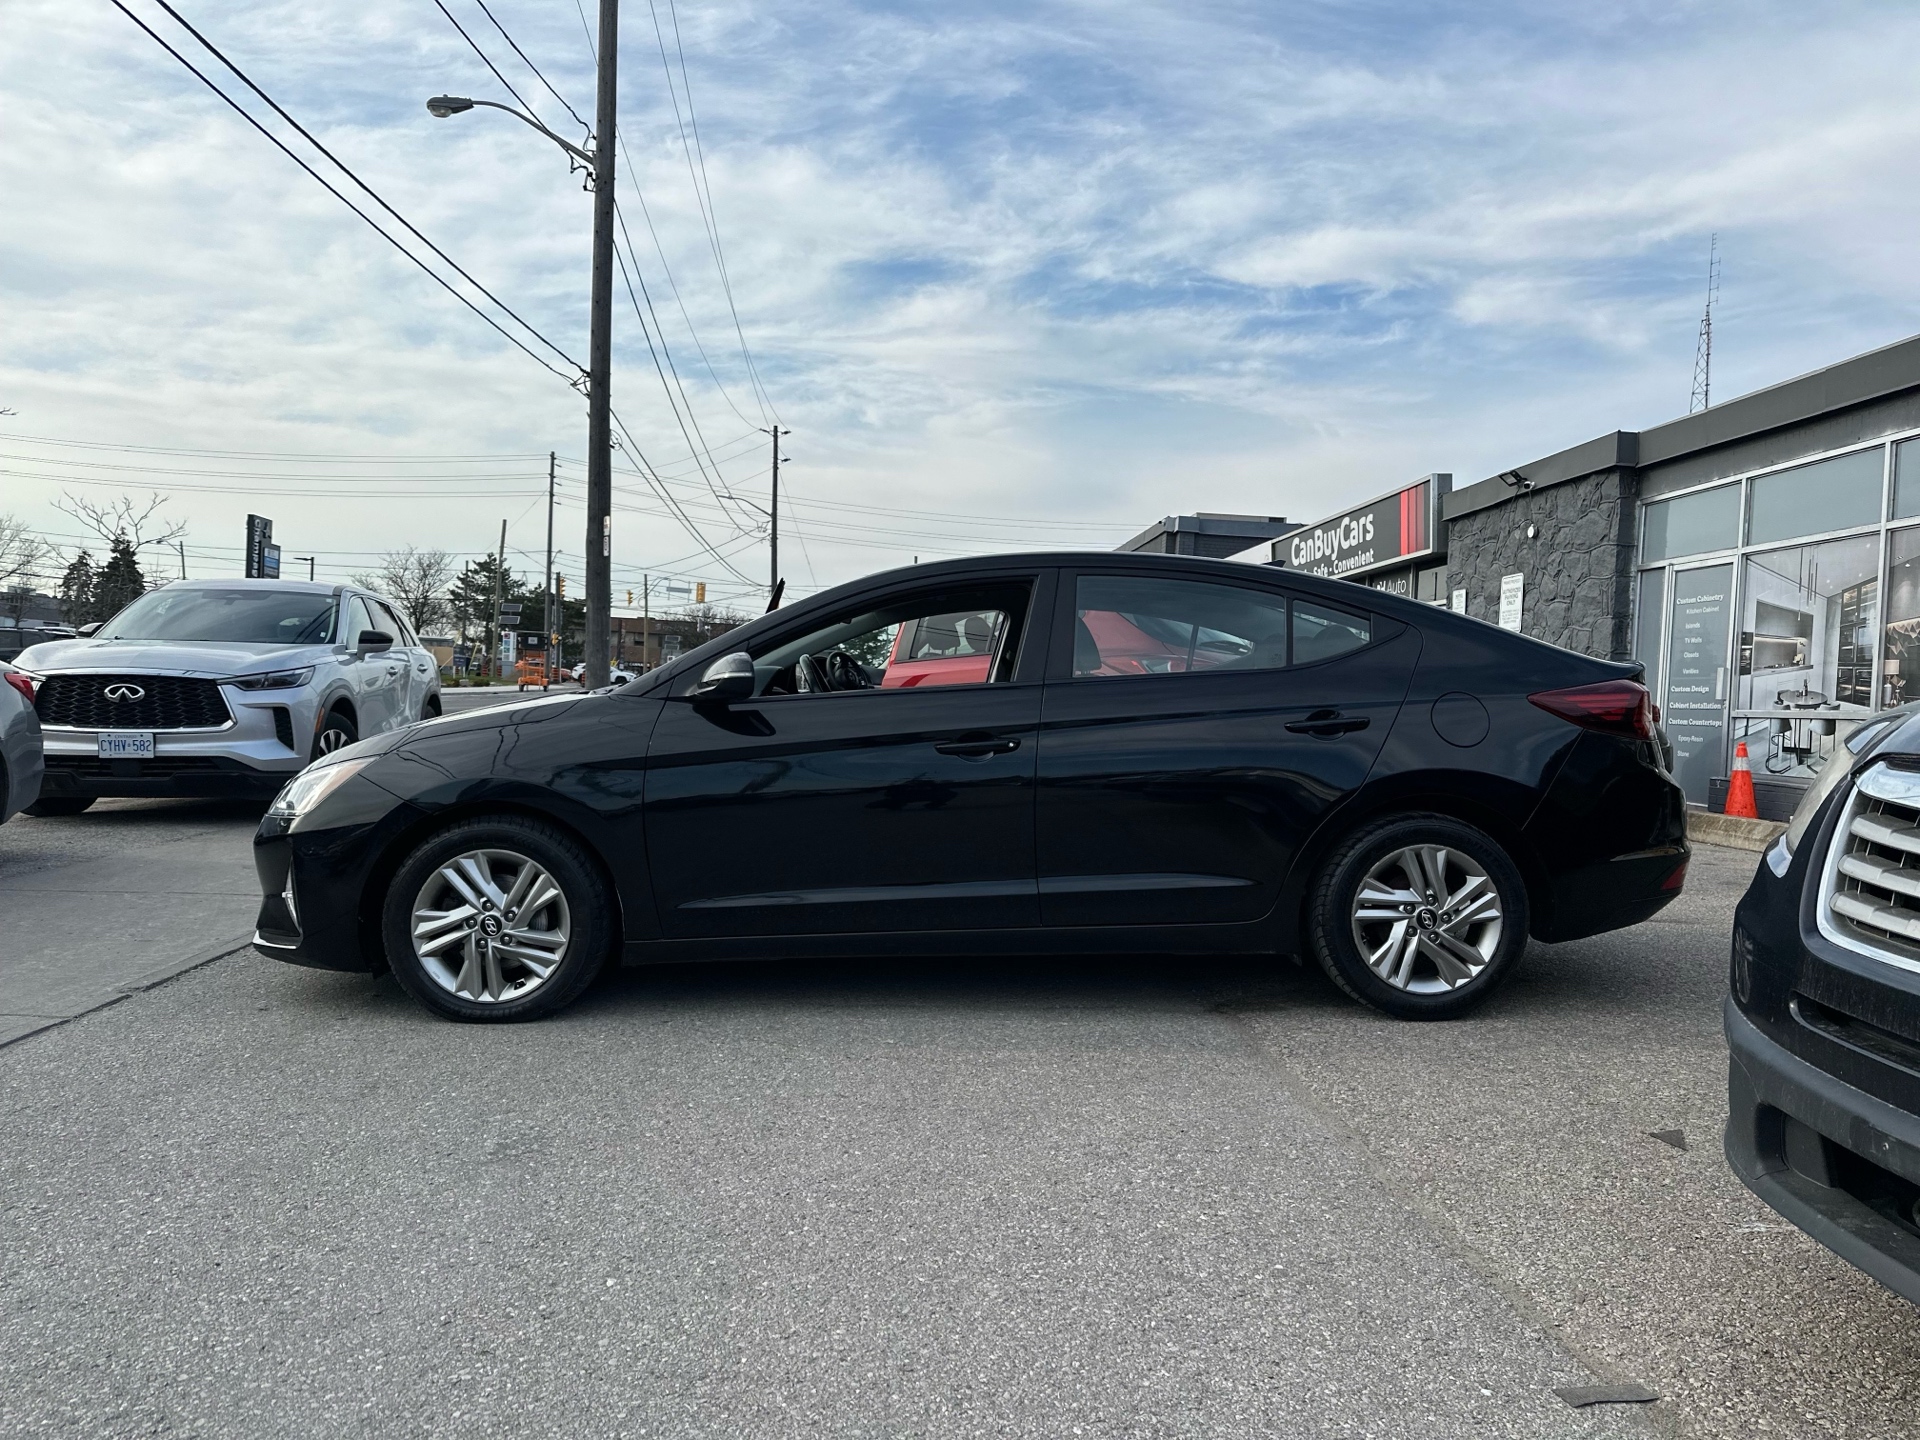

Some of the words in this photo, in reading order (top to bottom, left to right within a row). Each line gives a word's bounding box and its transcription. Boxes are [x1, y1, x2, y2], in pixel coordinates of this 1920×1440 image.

[1291, 513, 1374, 566] CanBuyCars
[1313, 563, 1328, 577] Safe
[1333, 548, 1374, 574] Convenient
[1386, 578, 1406, 594] Auto
[1676, 597, 1696, 605] Custom
[1697, 594, 1724, 603] Cabinetry
[1691, 685, 1709, 693] Design
[1689, 718, 1722, 727] Countertops
[100, 739, 126, 752] CYHV
[132, 739, 152, 752] 582
